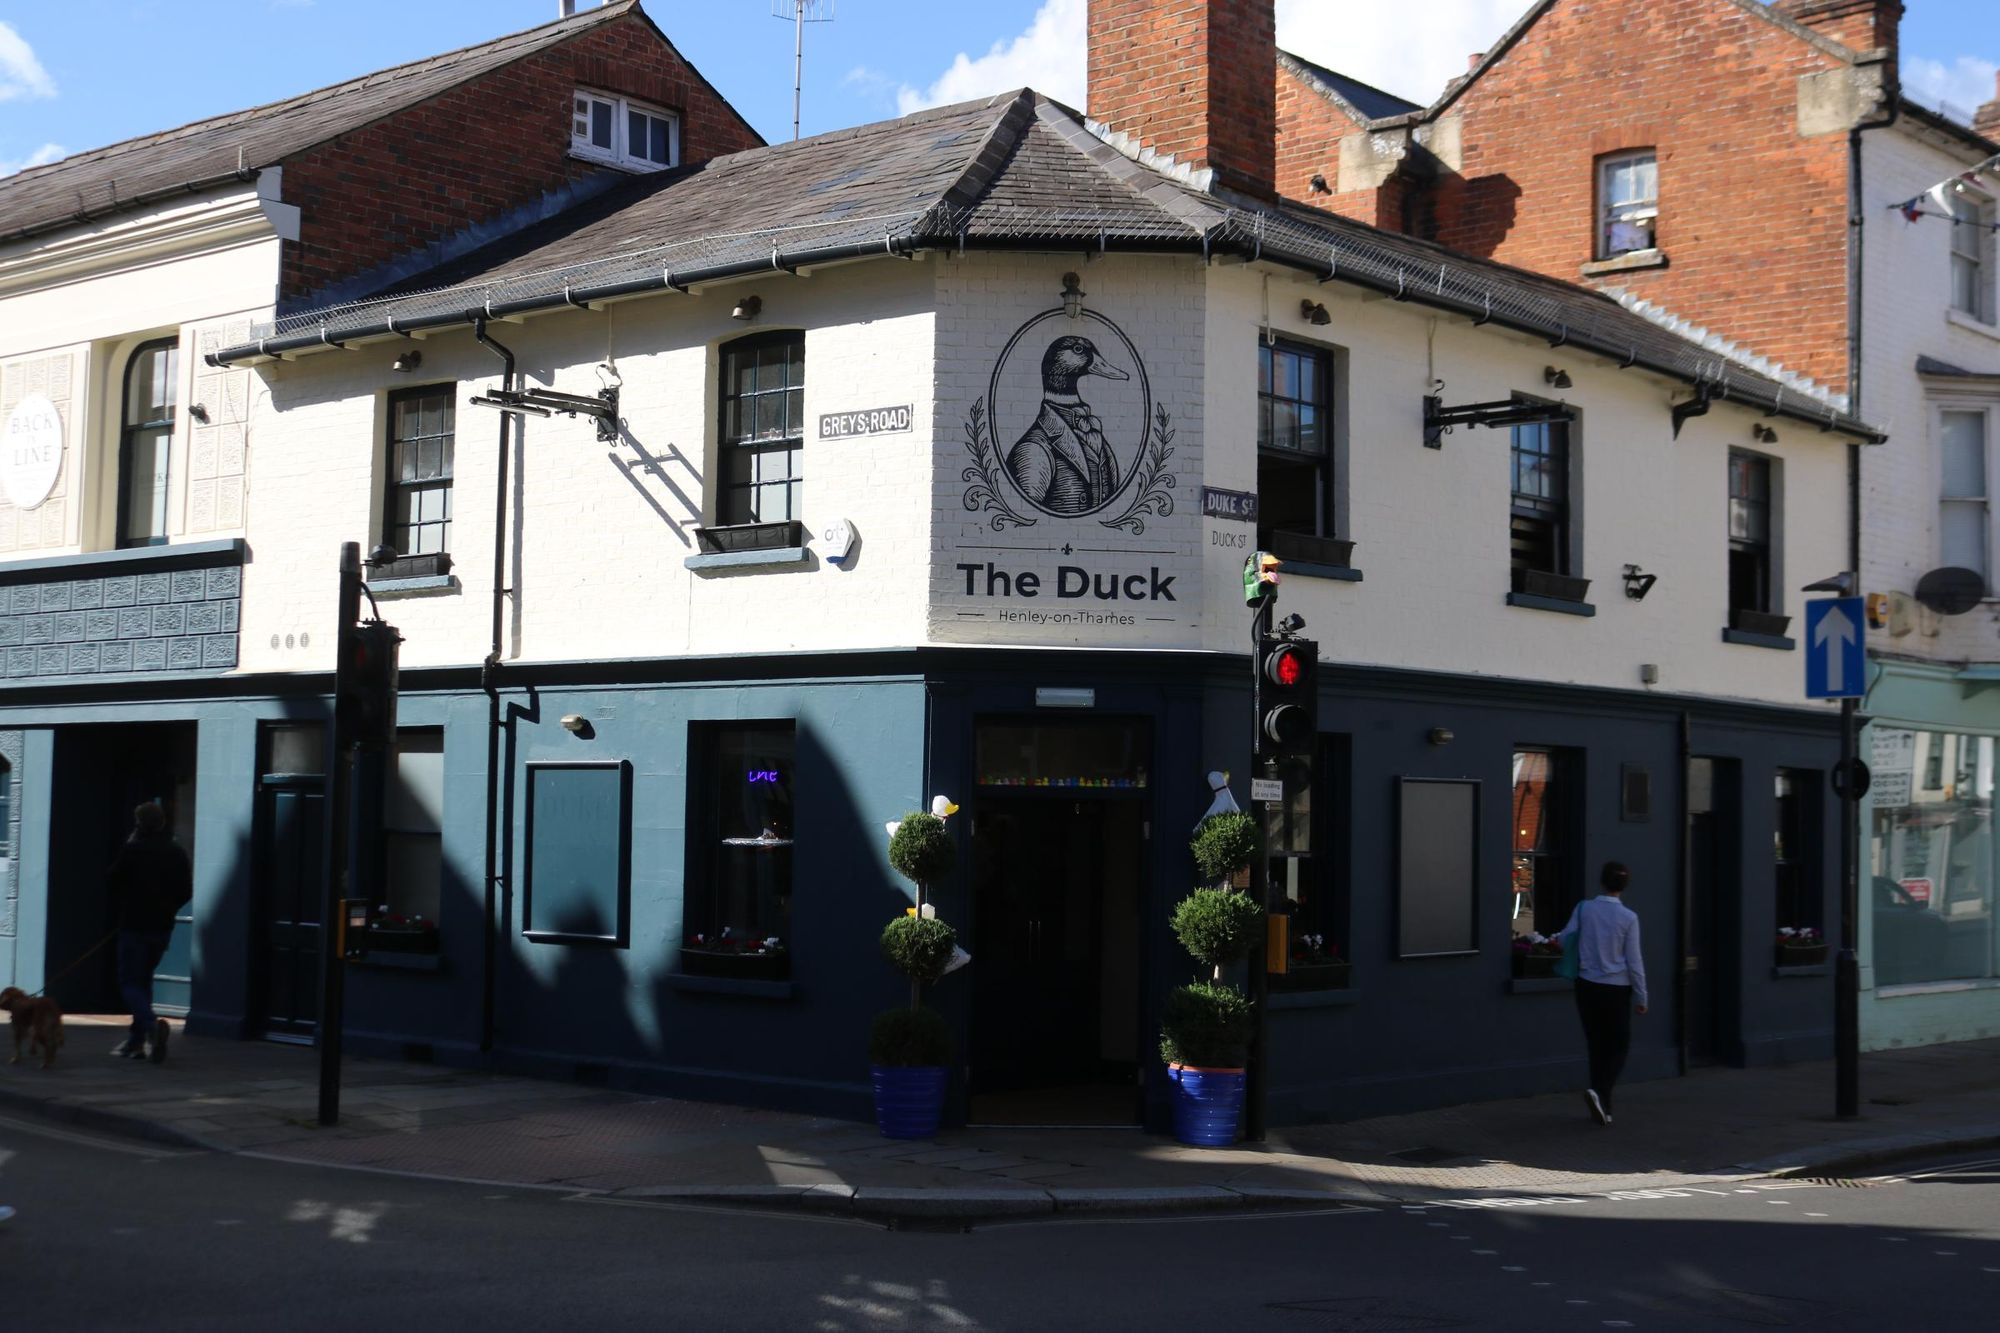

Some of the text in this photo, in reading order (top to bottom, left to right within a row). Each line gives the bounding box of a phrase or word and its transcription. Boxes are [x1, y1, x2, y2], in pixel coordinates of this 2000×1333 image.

[11, 413, 53, 434] BACK
[822, 408, 907, 436] GREYS ROAD
[14, 445, 52, 466] LINE
[1208, 492, 1237, 514] DUKE
[1212, 530, 1237, 547] DUCK
[956, 562, 1177, 601] The Duck
[999, 609, 1136, 626] Henley-on-Thames
